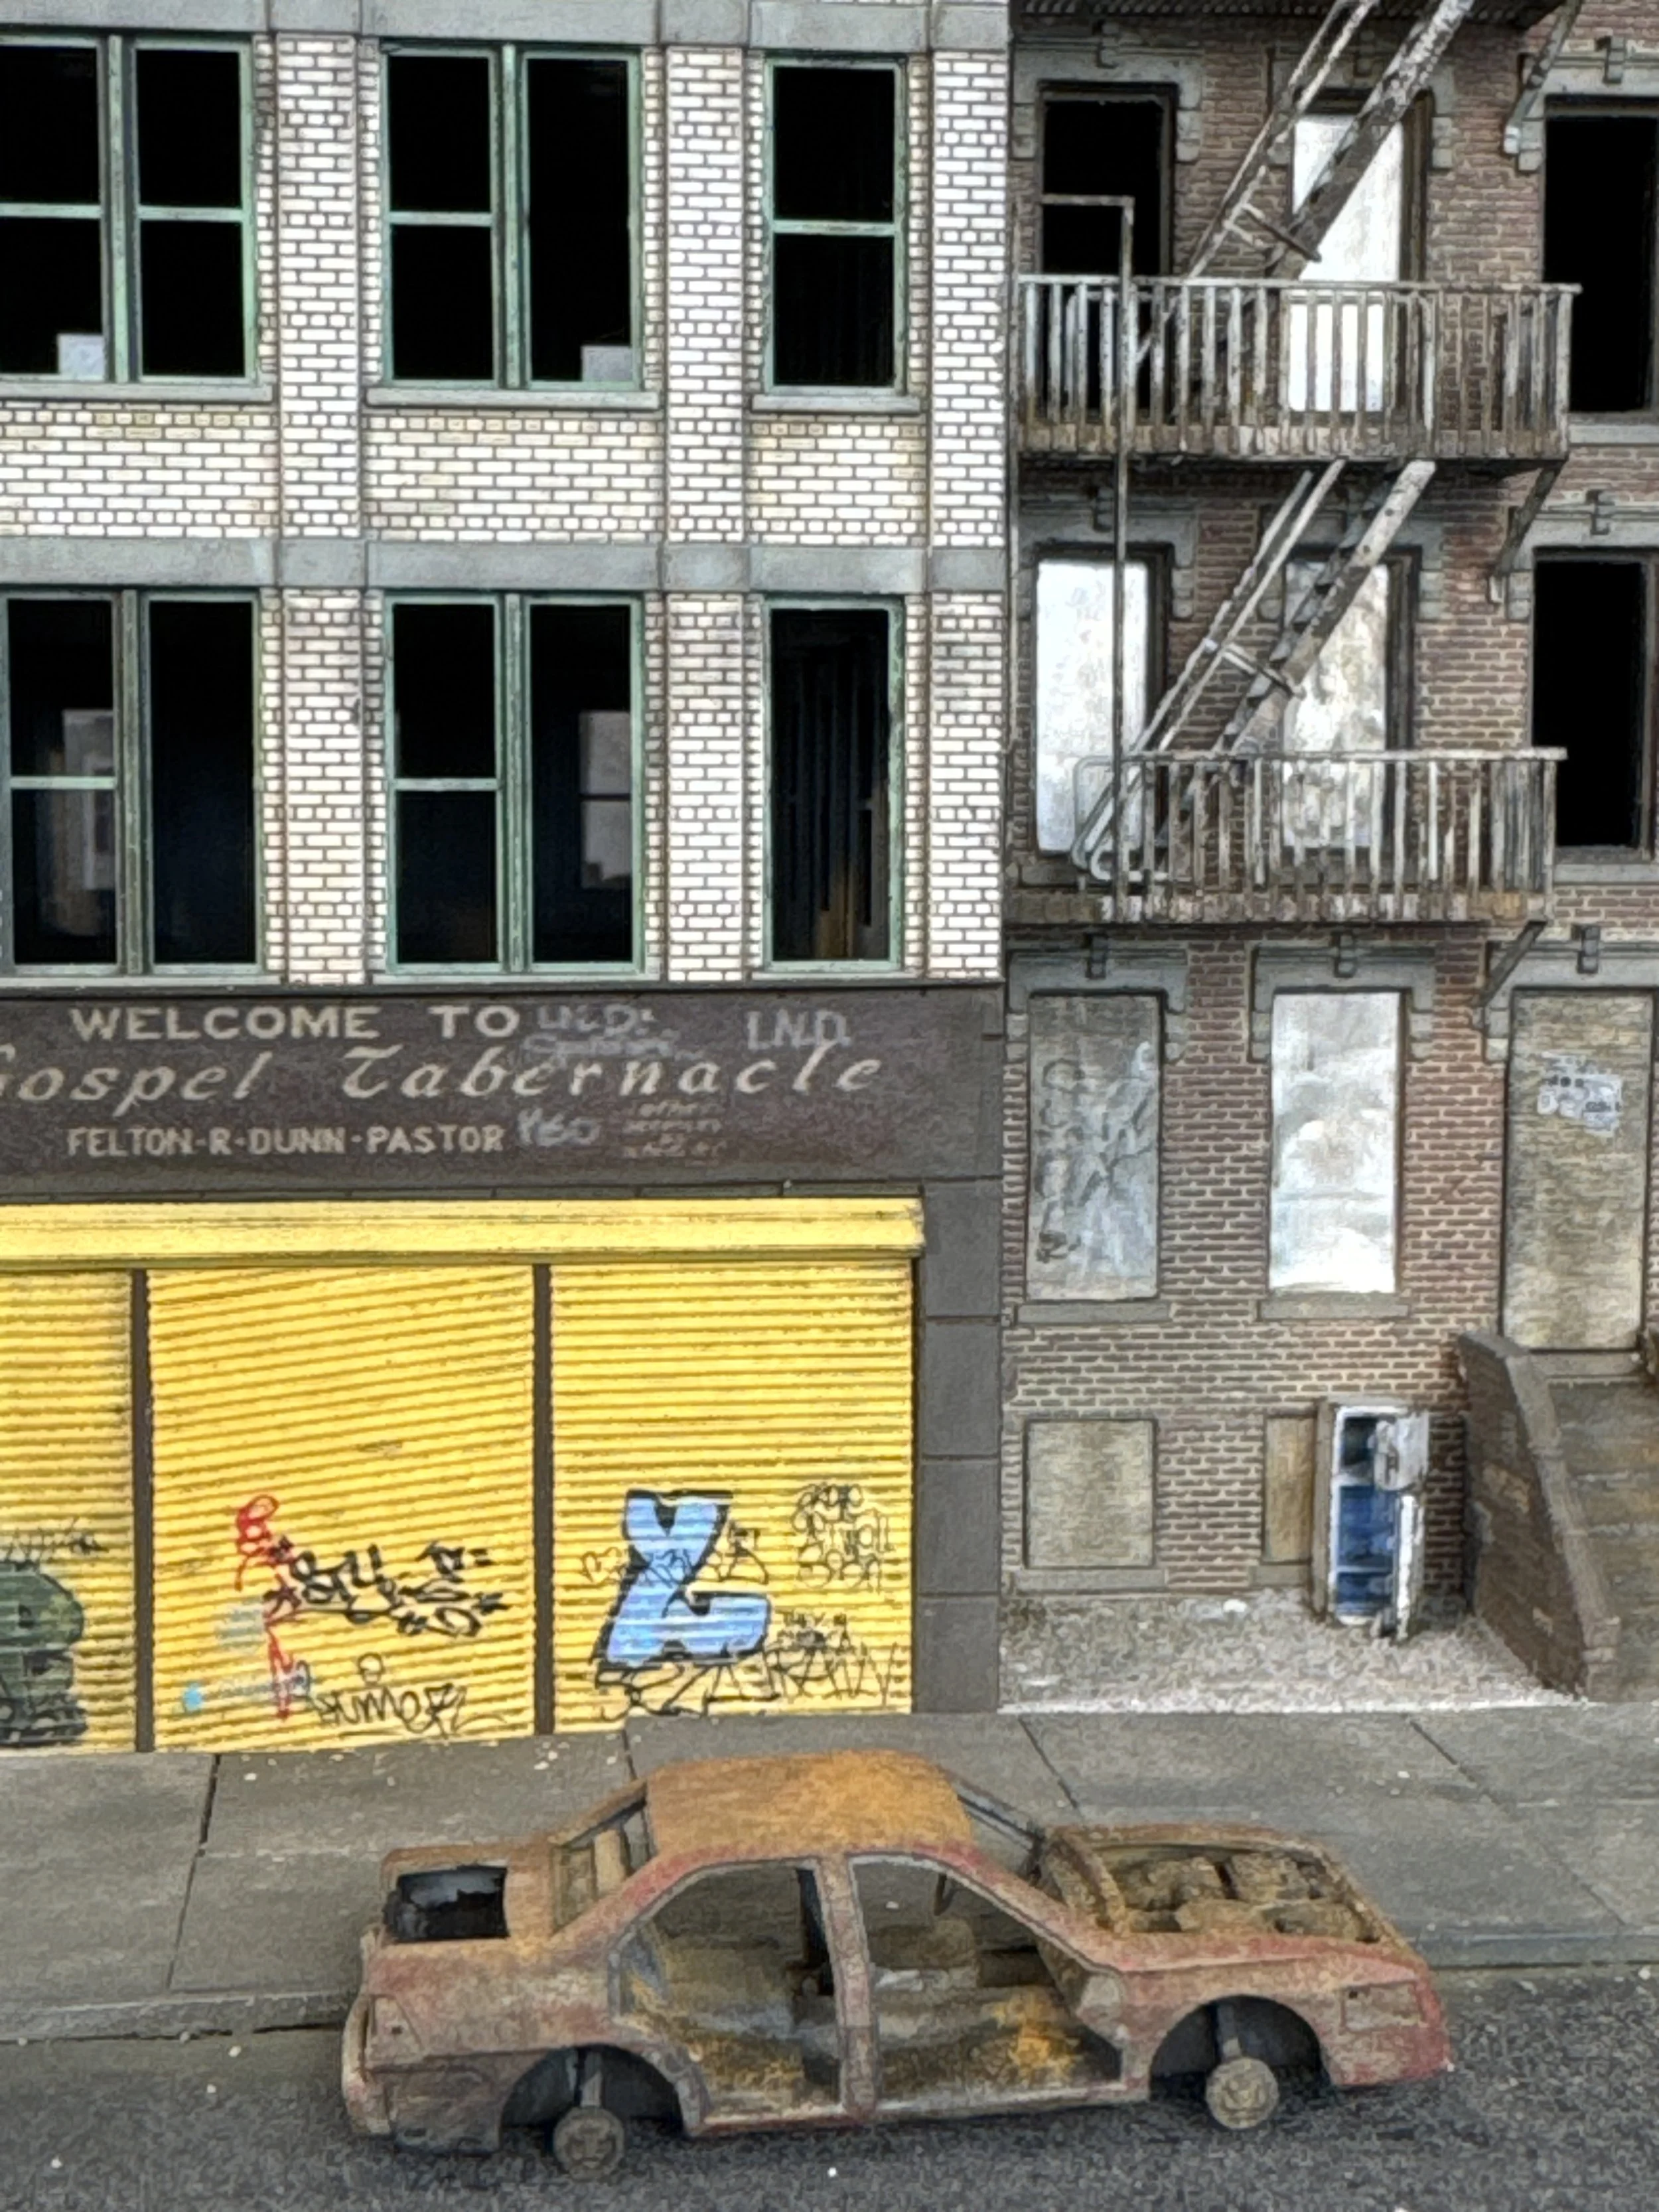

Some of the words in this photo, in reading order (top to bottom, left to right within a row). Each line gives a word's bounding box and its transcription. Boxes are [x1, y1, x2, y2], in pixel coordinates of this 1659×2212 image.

[69, 1005, 381, 1040] WELCOME
[427, 1005, 520, 1038] TO
[342, 1040, 881, 1095] Tabernacle
